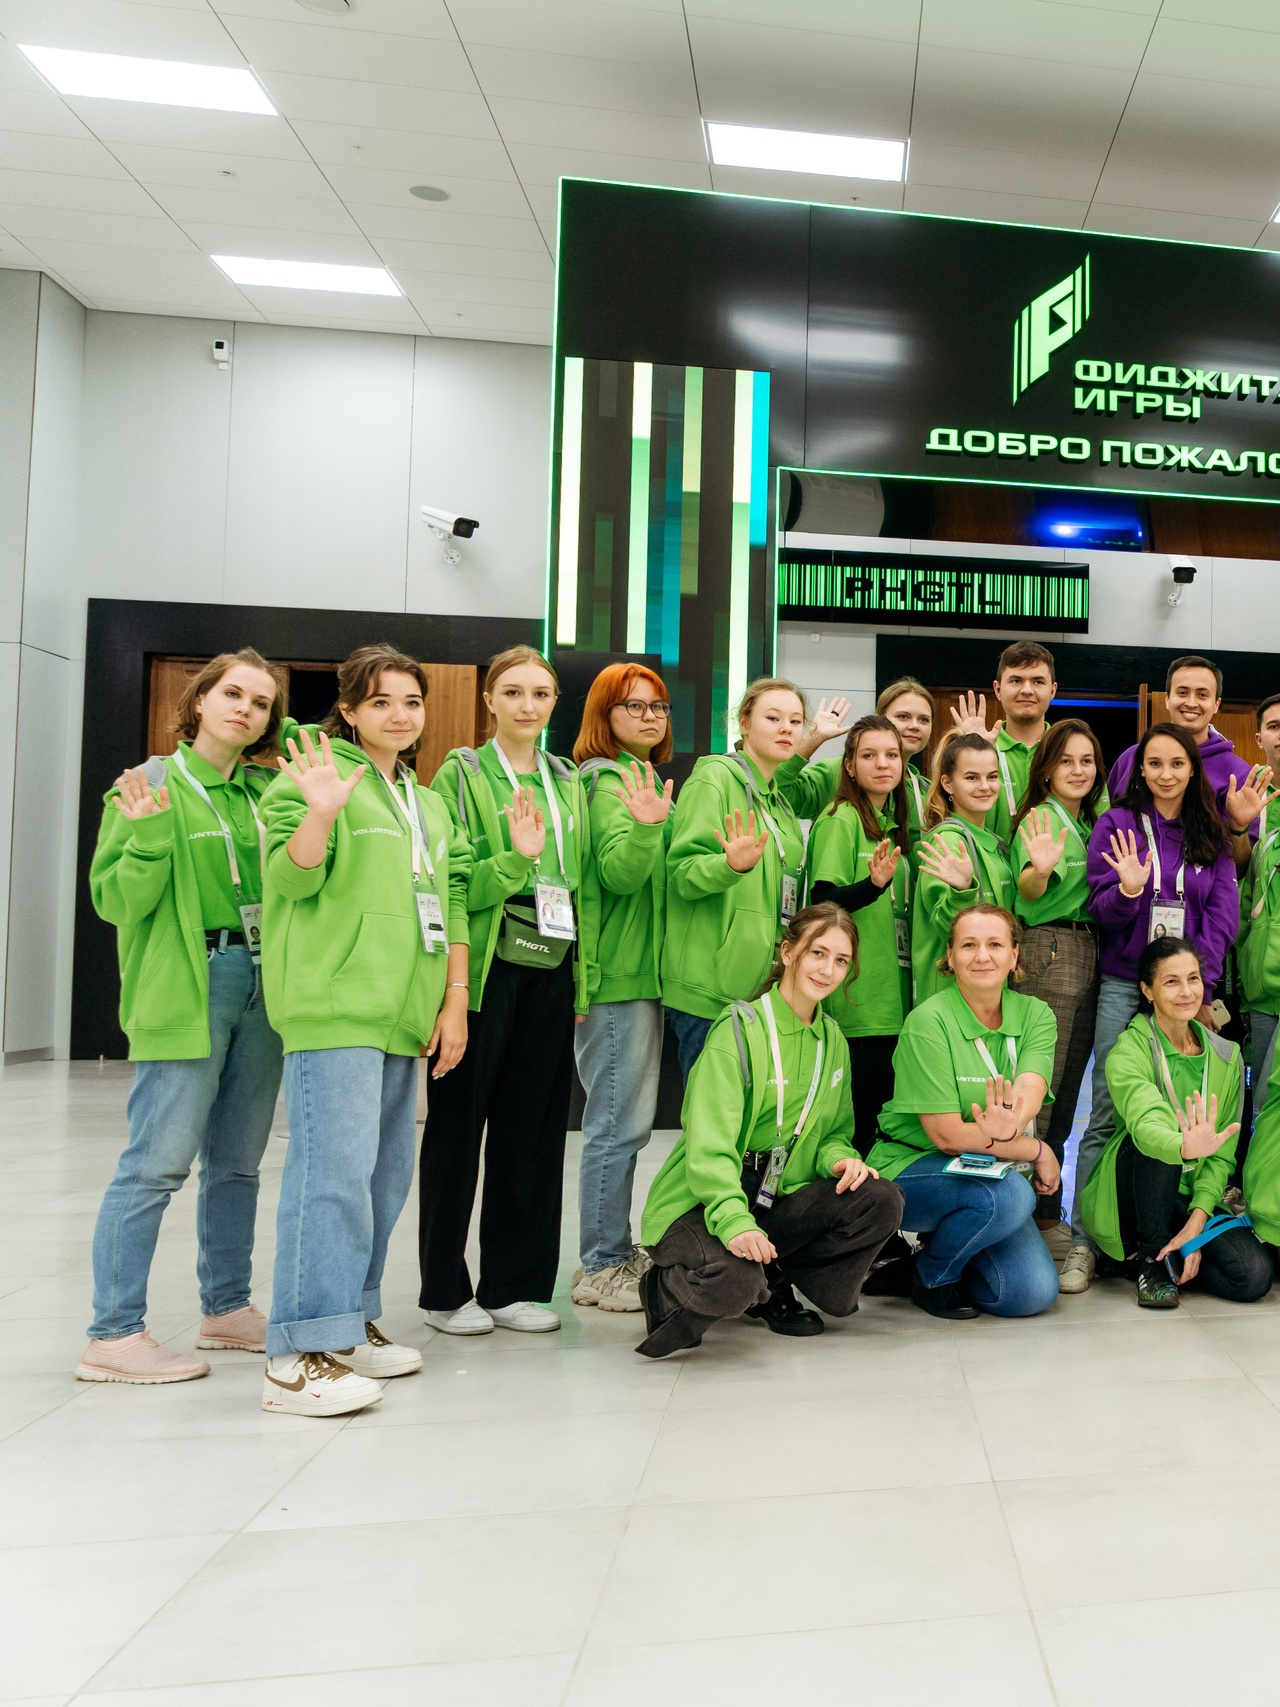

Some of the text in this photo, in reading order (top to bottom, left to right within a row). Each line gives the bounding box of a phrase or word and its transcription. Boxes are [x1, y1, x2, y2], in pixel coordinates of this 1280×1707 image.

[1074, 387, 1201, 418] ИГРЫ
[925, 427, 1091, 461] ДОБРО
[515, 938, 551, 954] PHGTL
